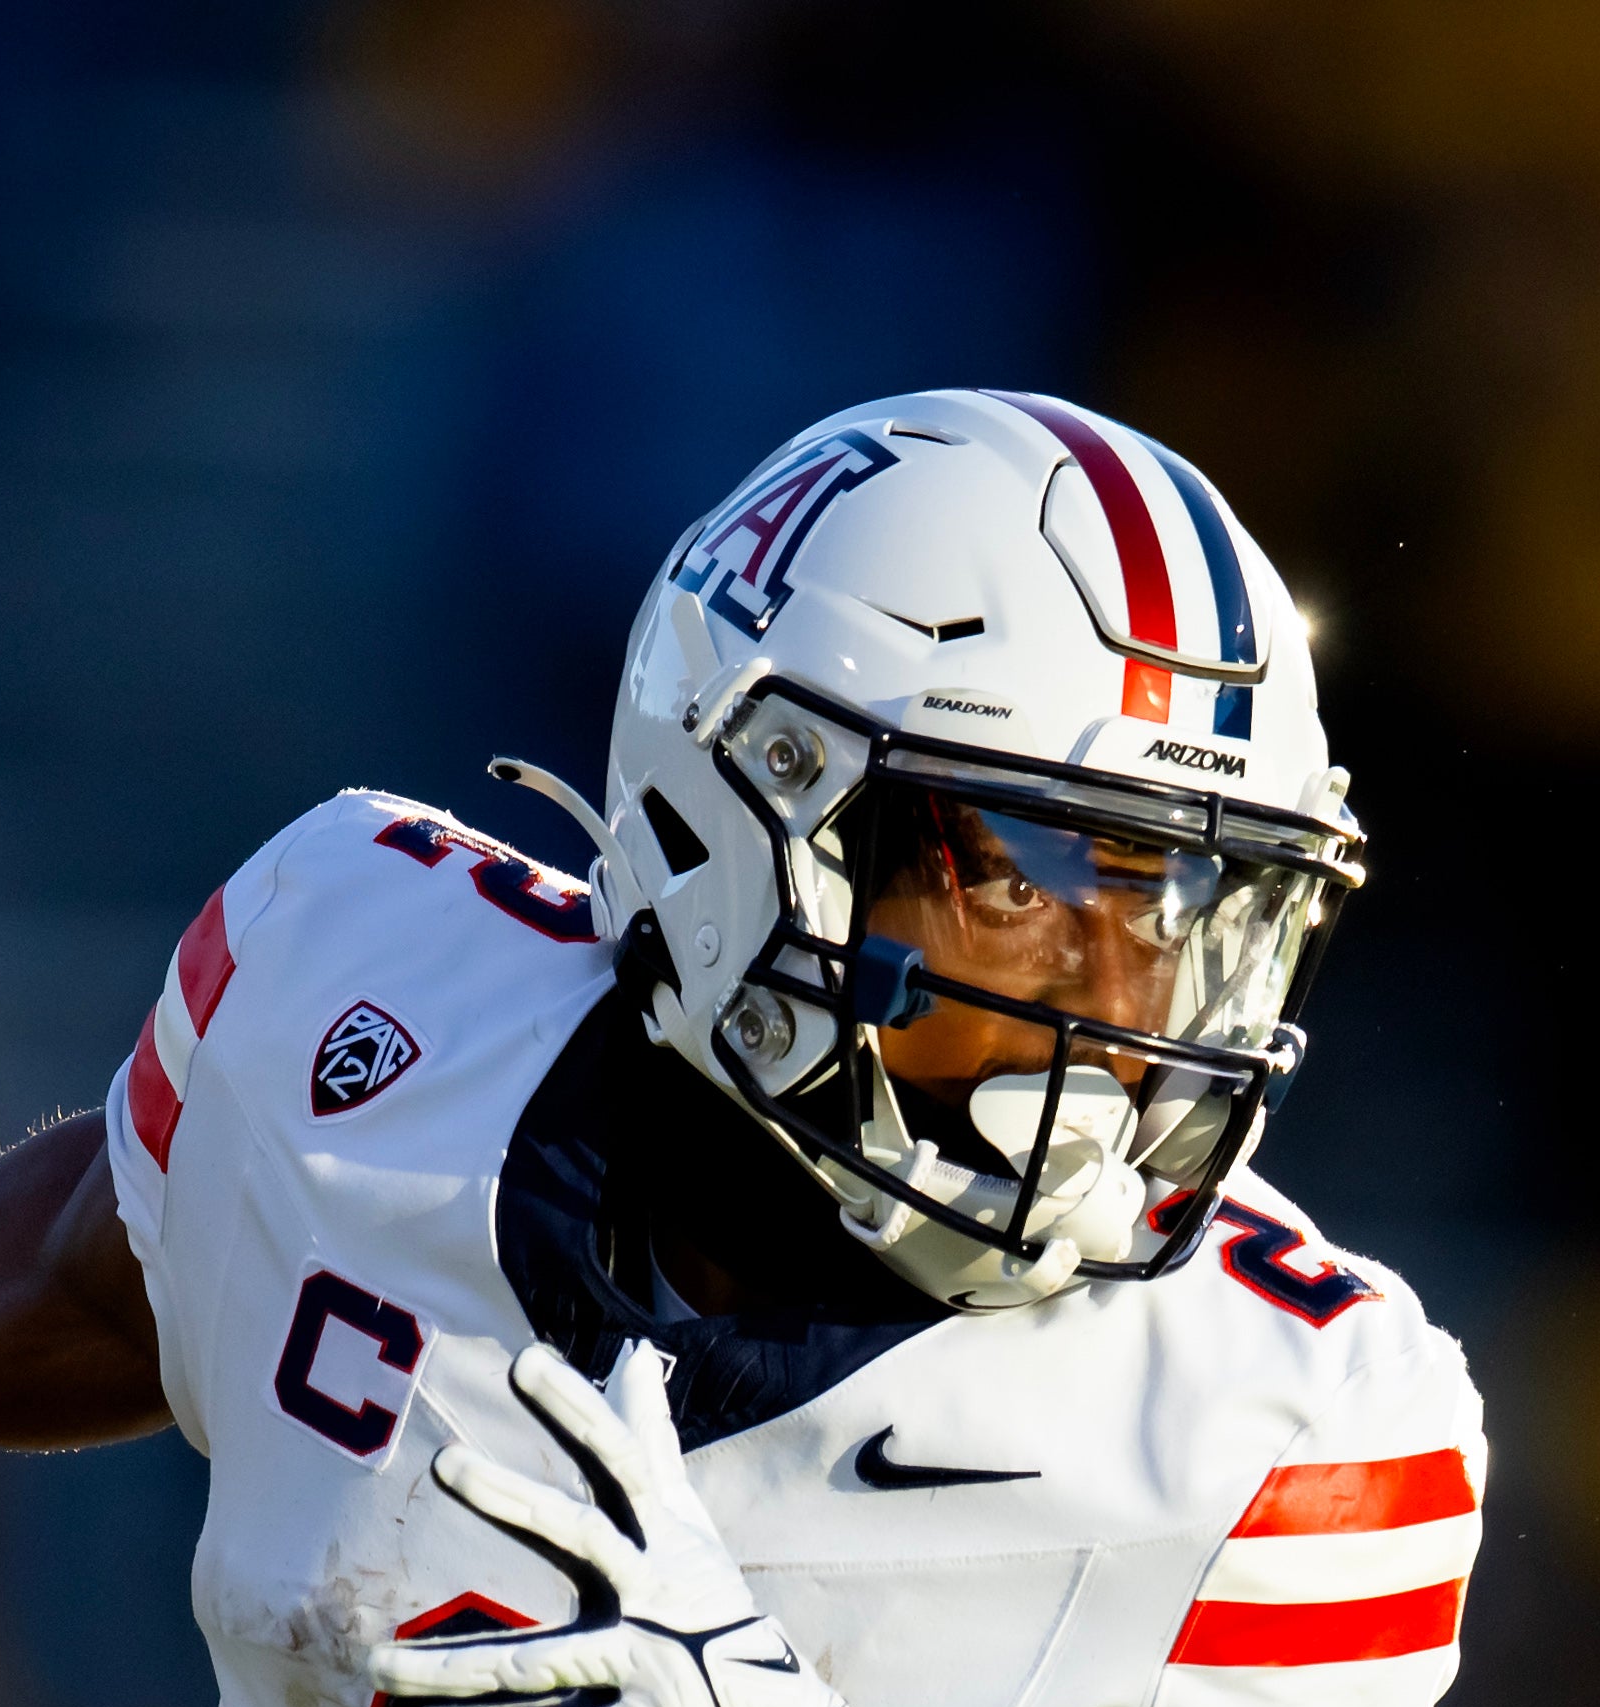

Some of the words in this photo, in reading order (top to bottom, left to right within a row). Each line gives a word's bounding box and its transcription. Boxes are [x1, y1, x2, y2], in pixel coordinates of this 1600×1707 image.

[667, 428, 901, 643] A
[922, 696, 1013, 719] BEARDOWN
[1142, 739, 1247, 779] ARIZONA
[317, 1047, 369, 1102] 12
[323, 1005, 413, 1092] PAC
[1146, 1188, 1386, 1330] 2
[274, 1268, 425, 1458] C
